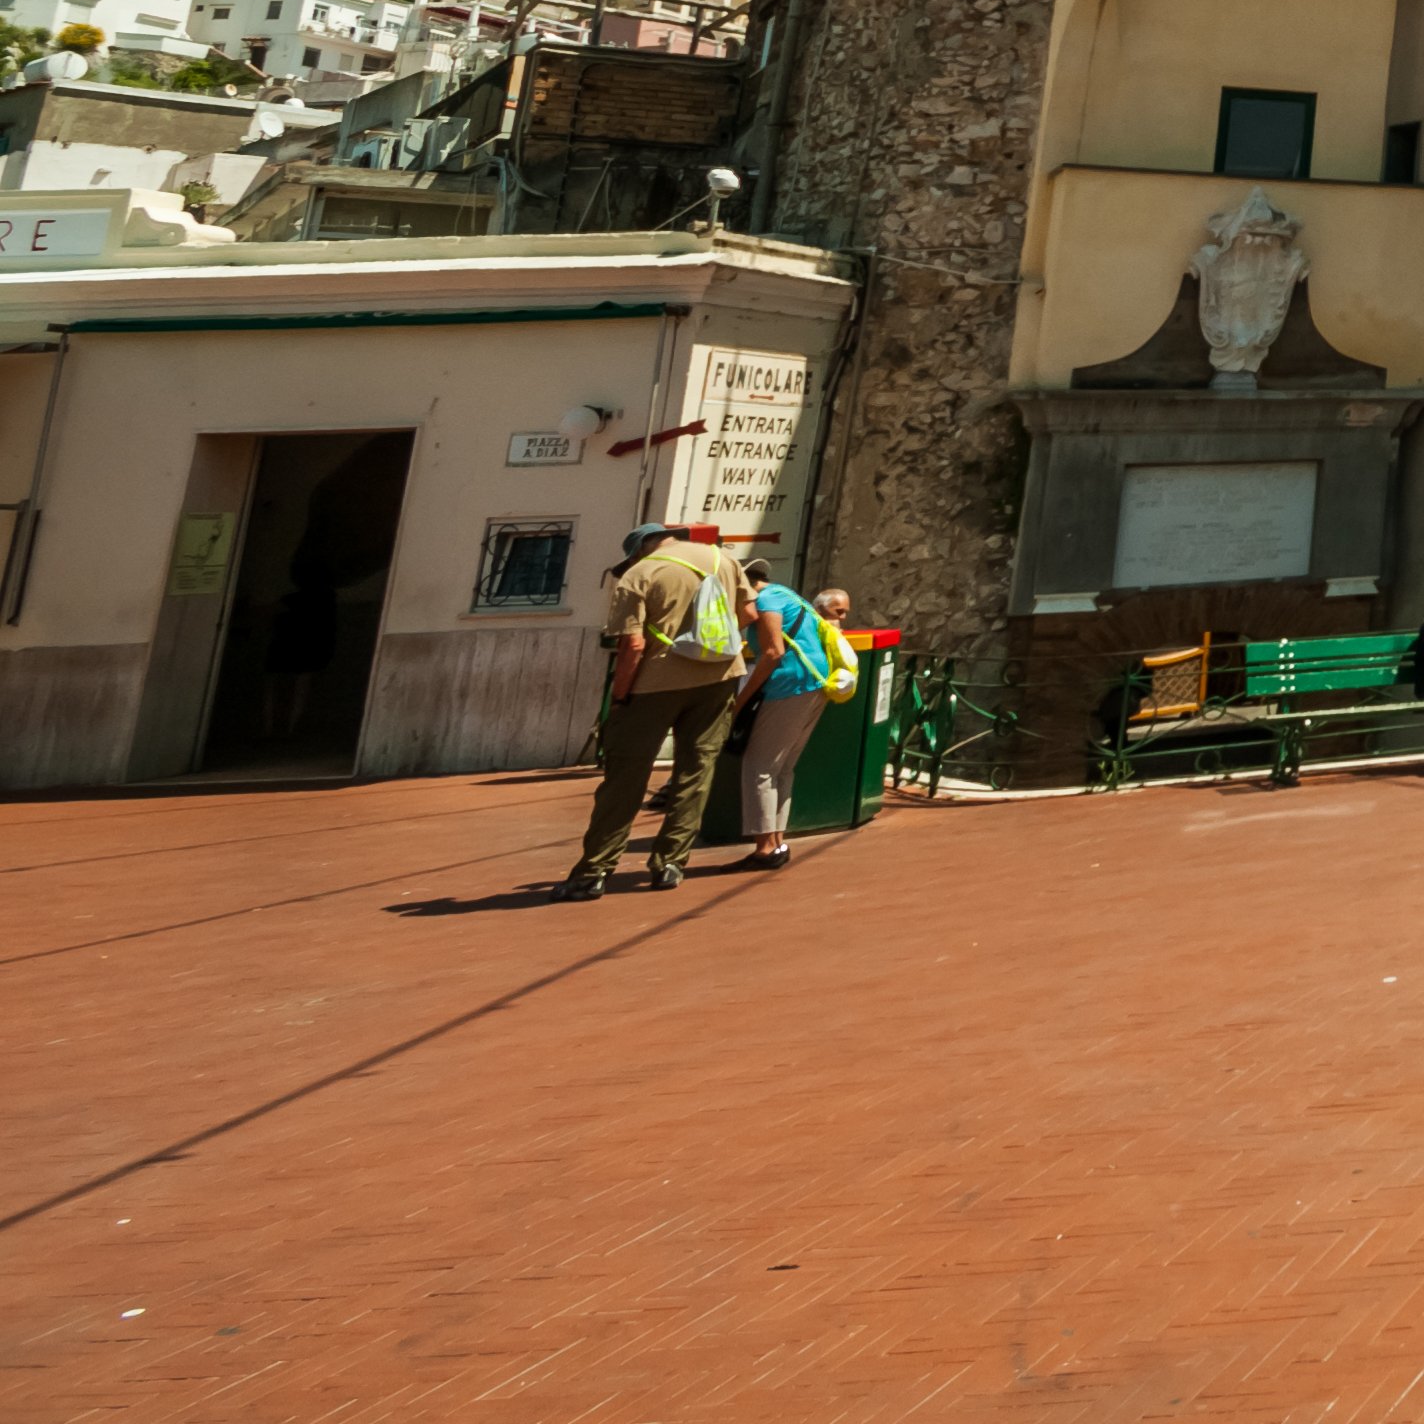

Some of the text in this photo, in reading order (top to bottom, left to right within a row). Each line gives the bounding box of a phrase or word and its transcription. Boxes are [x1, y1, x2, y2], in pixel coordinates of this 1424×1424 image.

[711, 361, 814, 396] FUNICOLARE
[720, 414, 795, 436] ENTRATA
[527, 437, 571, 448] PIAZZA
[535, 447, 570, 458] DIAZ
[707, 440, 798, 461] ENTRANCE
[721, 467, 780, 486] WAY IN
[702, 493, 788, 513] EINFAHRT
